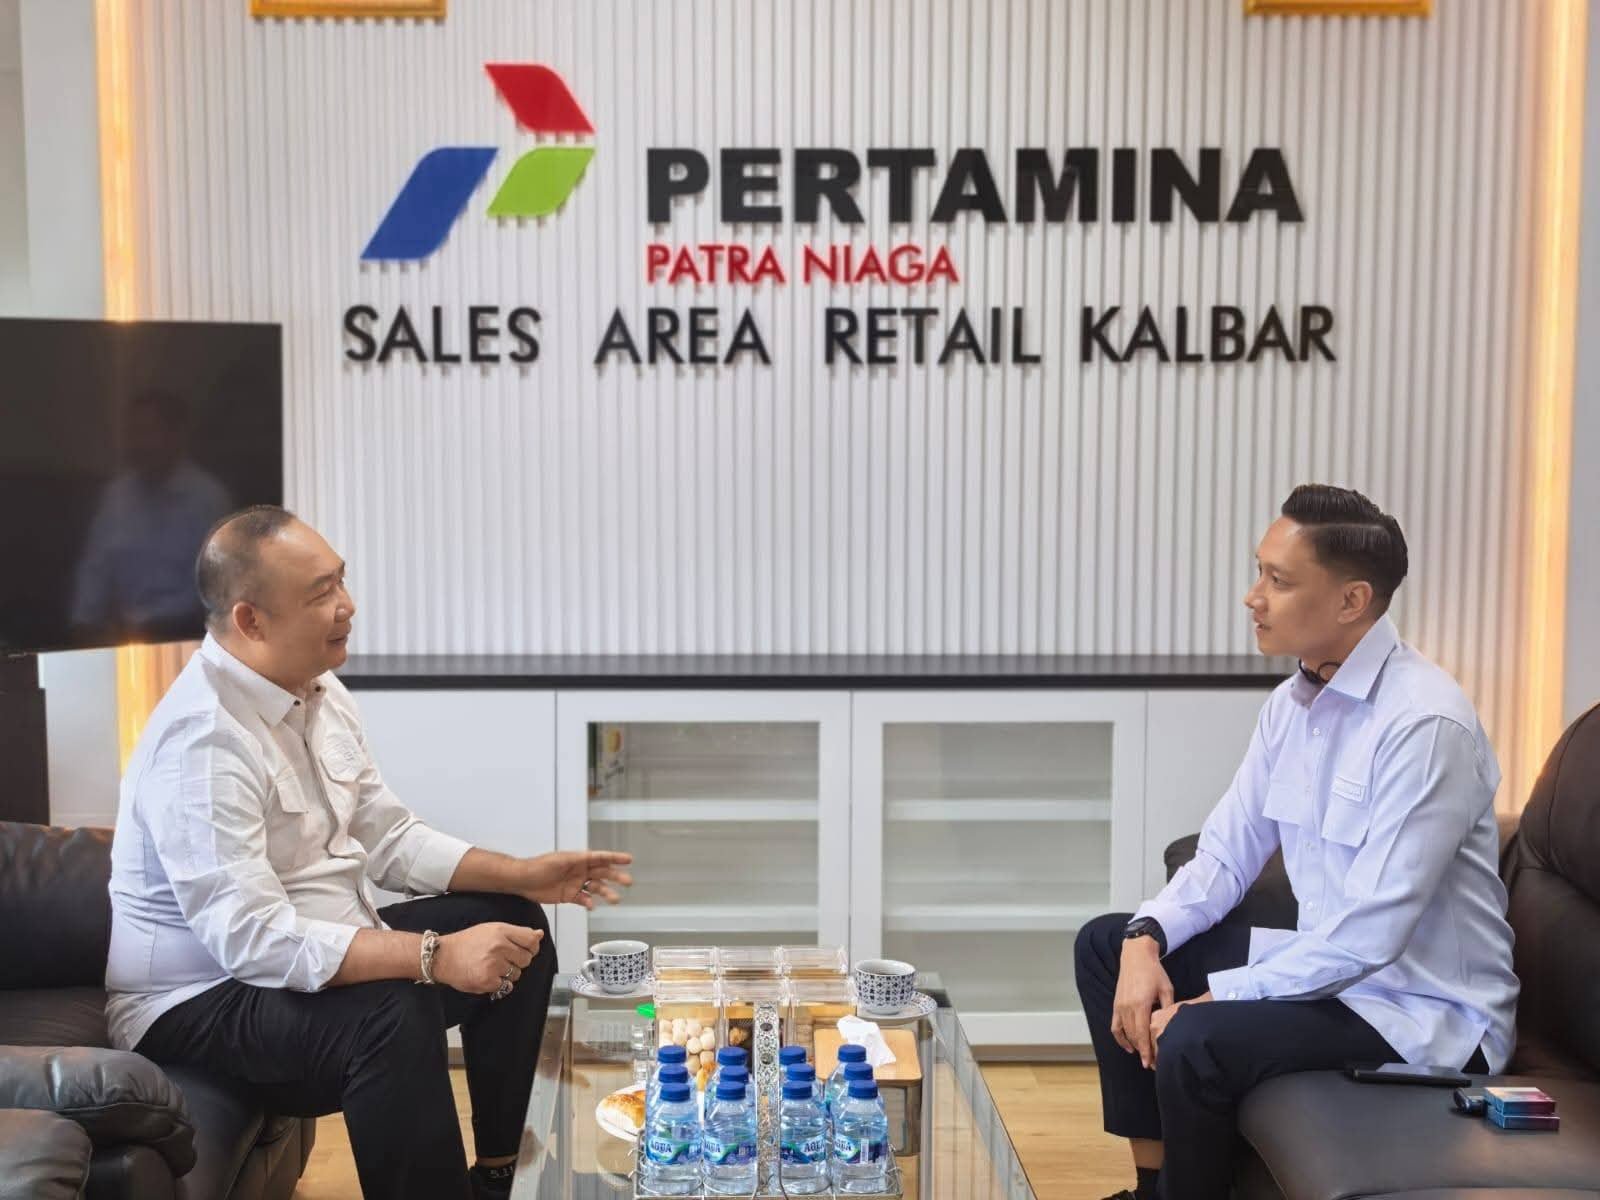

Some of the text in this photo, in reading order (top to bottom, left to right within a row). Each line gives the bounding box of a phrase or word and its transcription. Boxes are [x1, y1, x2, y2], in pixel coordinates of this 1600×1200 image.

[647, 147, 1304, 223] PERTAMINA
[647, 244, 959, 285] PATRA NIAGA
[343, 305, 1336, 365] SALES AREA RETAIL KALBAR
